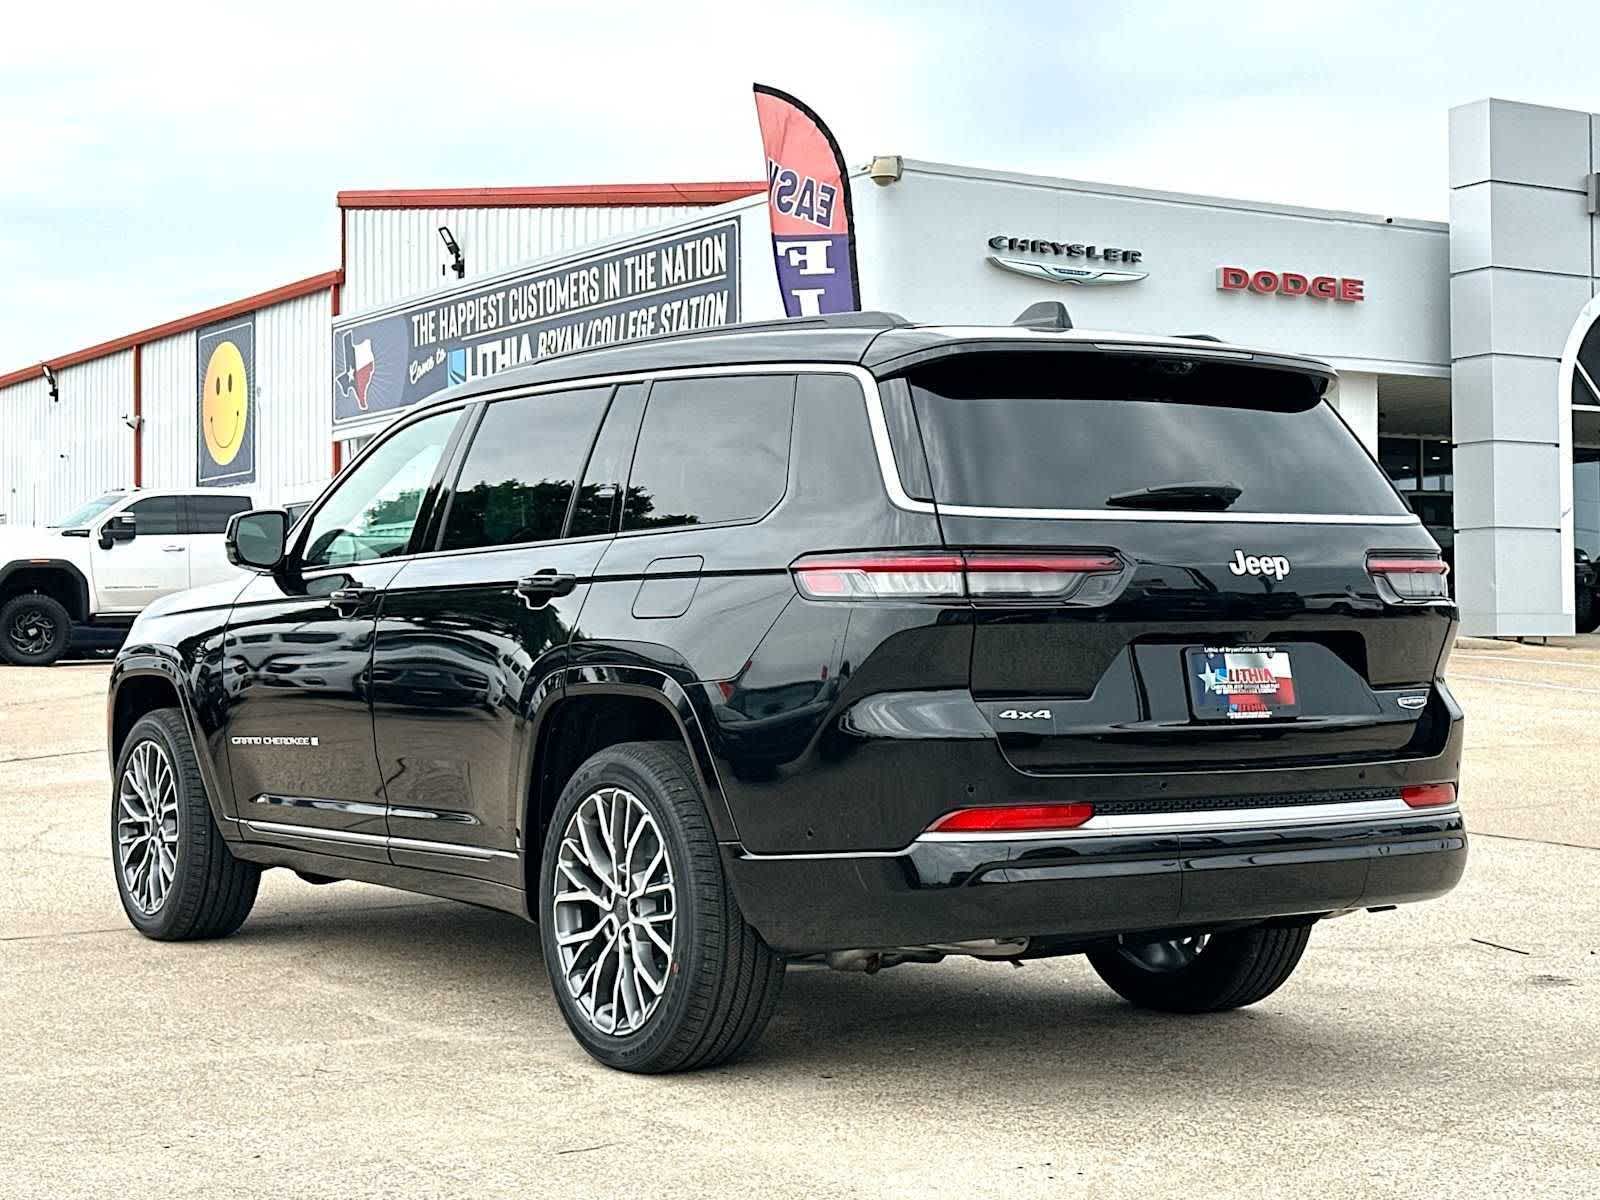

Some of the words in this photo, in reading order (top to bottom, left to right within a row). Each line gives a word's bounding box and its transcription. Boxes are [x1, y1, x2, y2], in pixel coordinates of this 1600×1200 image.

[988, 235, 1142, 263] CHRYSLER
[411, 310, 437, 348] THE
[439, 291, 506, 341] HAPPIEST
[508, 265, 600, 323] CUSTOMERS
[603, 260, 620, 300] IN
[624, 251, 657, 294] THE
[661, 233, 727, 287] NATION
[1215, 265, 1365, 301] DODGE
[409, 356, 435, 385] Come
[436, 347, 447, 365] to
[466, 333, 533, 383] LITHIA
[659, 290, 729, 335] STATION
[1228, 550, 1290, 581] Jeep
[1228, 668, 1277, 683] LITHIA
[998, 709, 1052, 720] 4x4
[231, 736, 262, 745] GRAND
[262, 736, 310, 746] CHEROKEE
